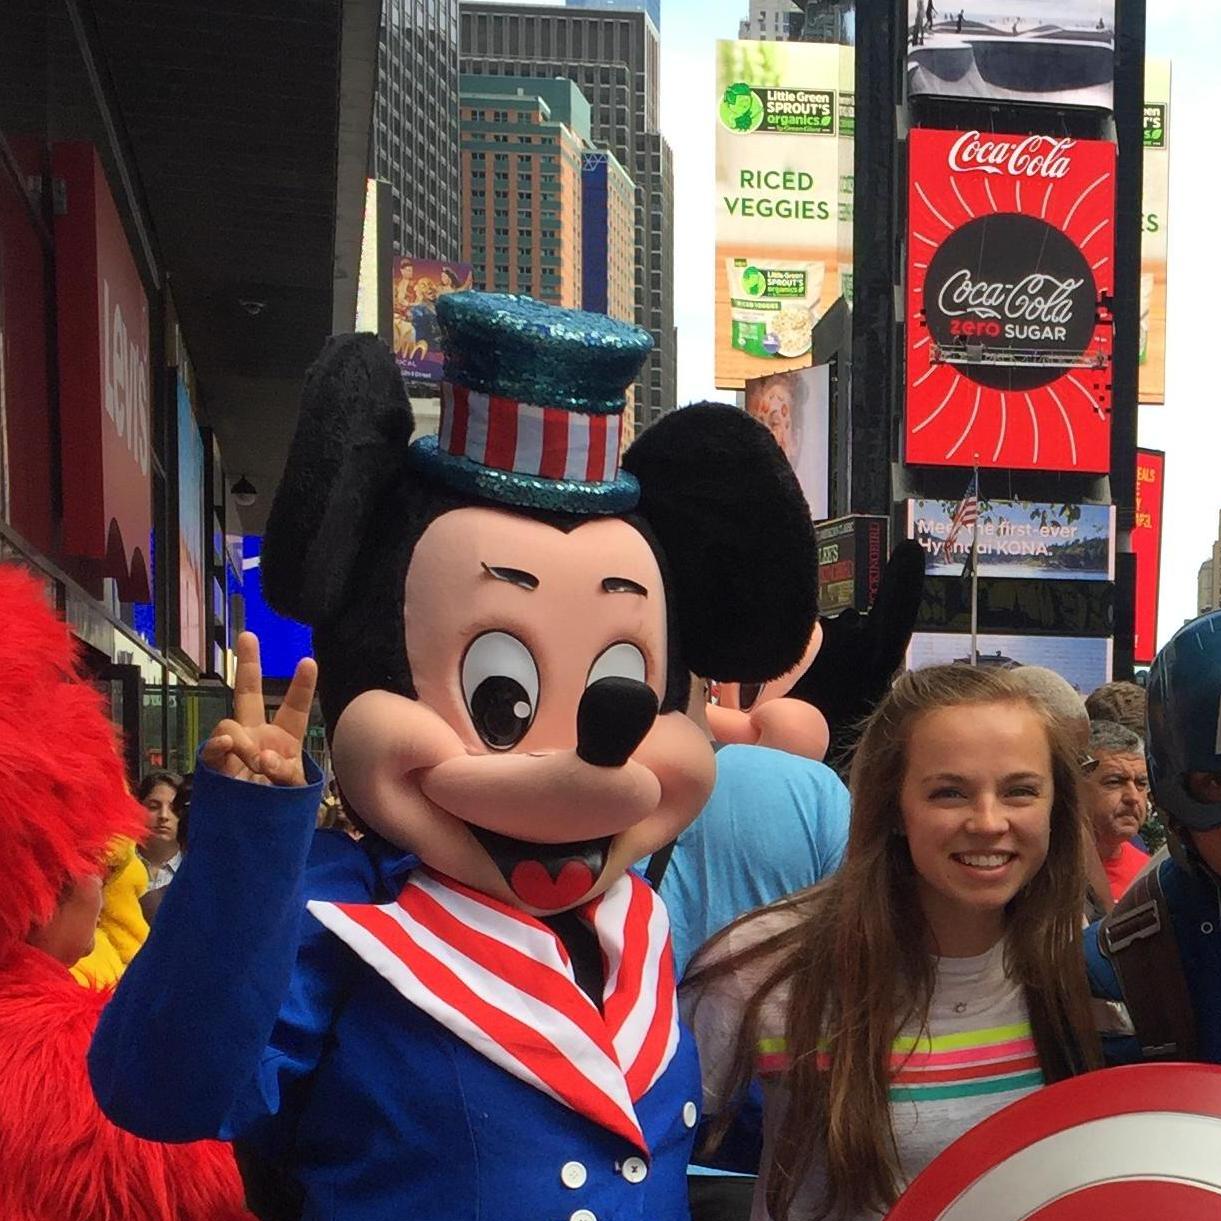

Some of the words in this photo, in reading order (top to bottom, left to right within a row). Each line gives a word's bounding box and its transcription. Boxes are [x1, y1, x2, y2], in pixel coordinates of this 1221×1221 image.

[767, 90, 795, 102] Little
[796, 92, 830, 103] Green
[767, 101, 830, 116] SPROUT'S
[767, 114, 820, 126] organics
[948, 130, 1077, 178] Coca-Cola
[740, 169, 814, 191] RICED
[723, 197, 830, 220] VEGGIES
[938, 269, 1085, 323] Coca-Cola
[950, 320, 1000, 338] zero
[1004, 324, 1067, 341] SUGAR
[999, 519, 1078, 539] first-ever
